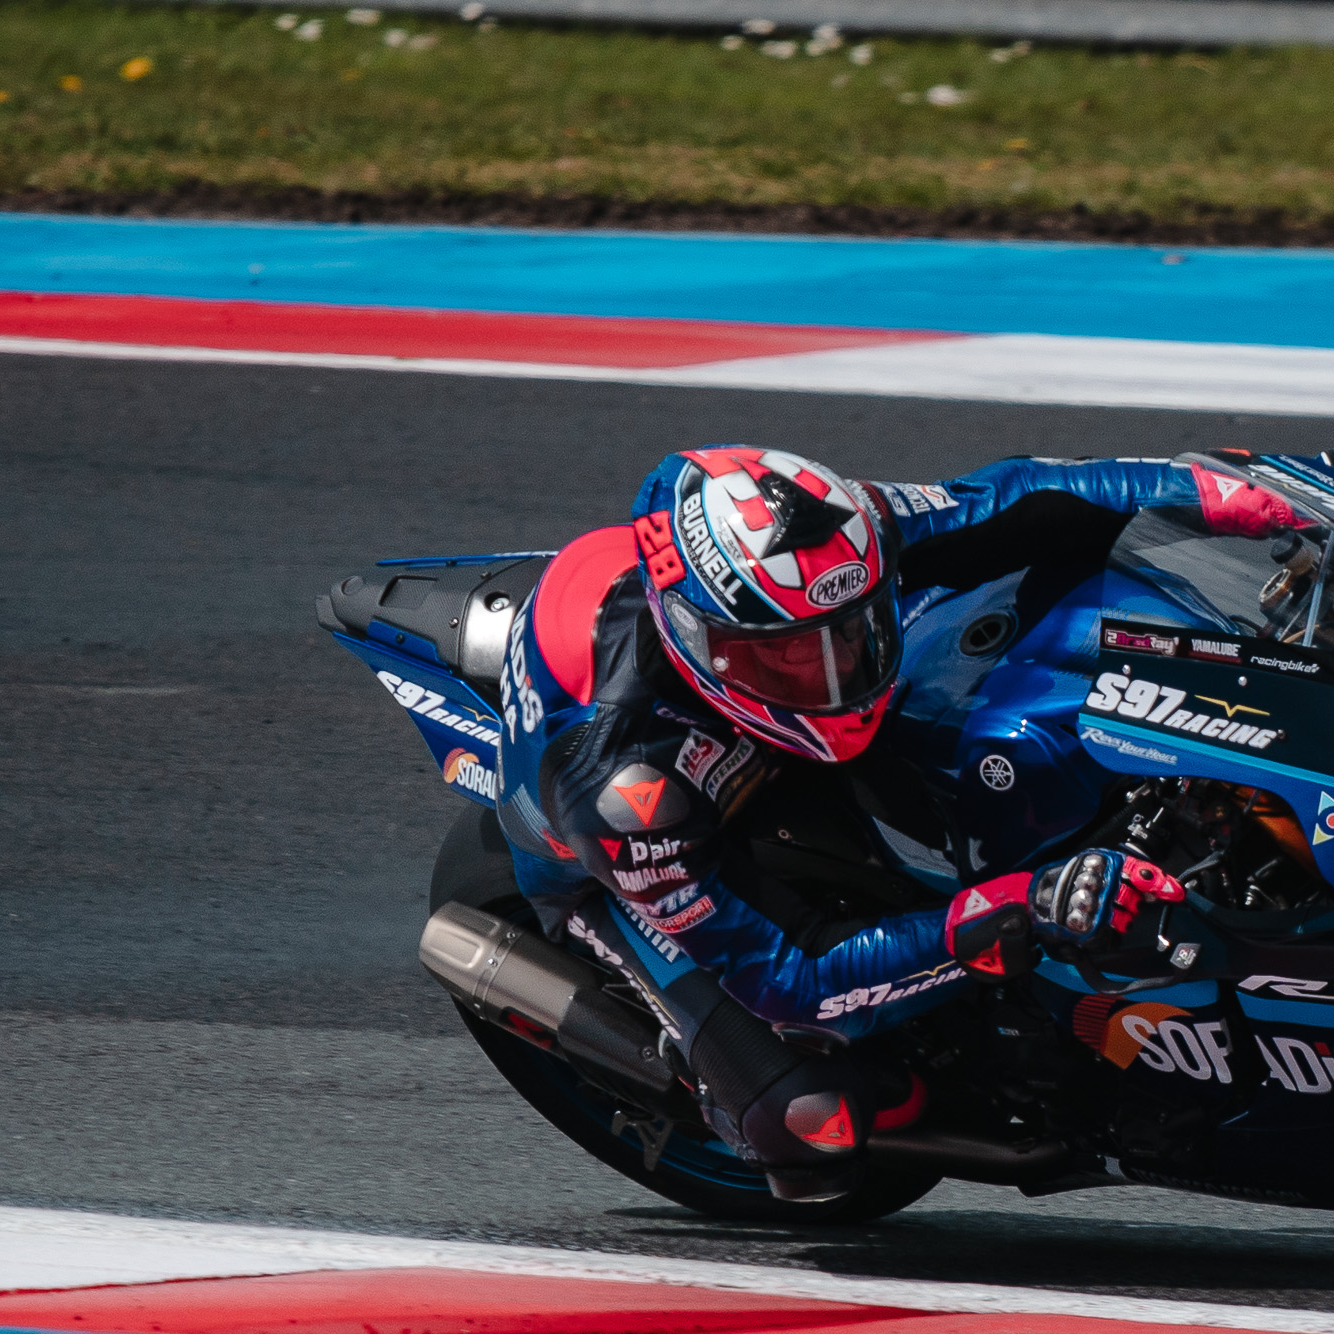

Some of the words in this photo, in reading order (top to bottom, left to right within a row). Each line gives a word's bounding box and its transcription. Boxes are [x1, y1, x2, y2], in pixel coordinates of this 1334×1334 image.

[633, 509, 687, 592] 28
[682, 492, 744, 606] BURNELL
[816, 567, 866, 603] PREMIER
[1191, 638, 1242, 658] YAMALUBE
[457, 757, 497, 801] SORA
